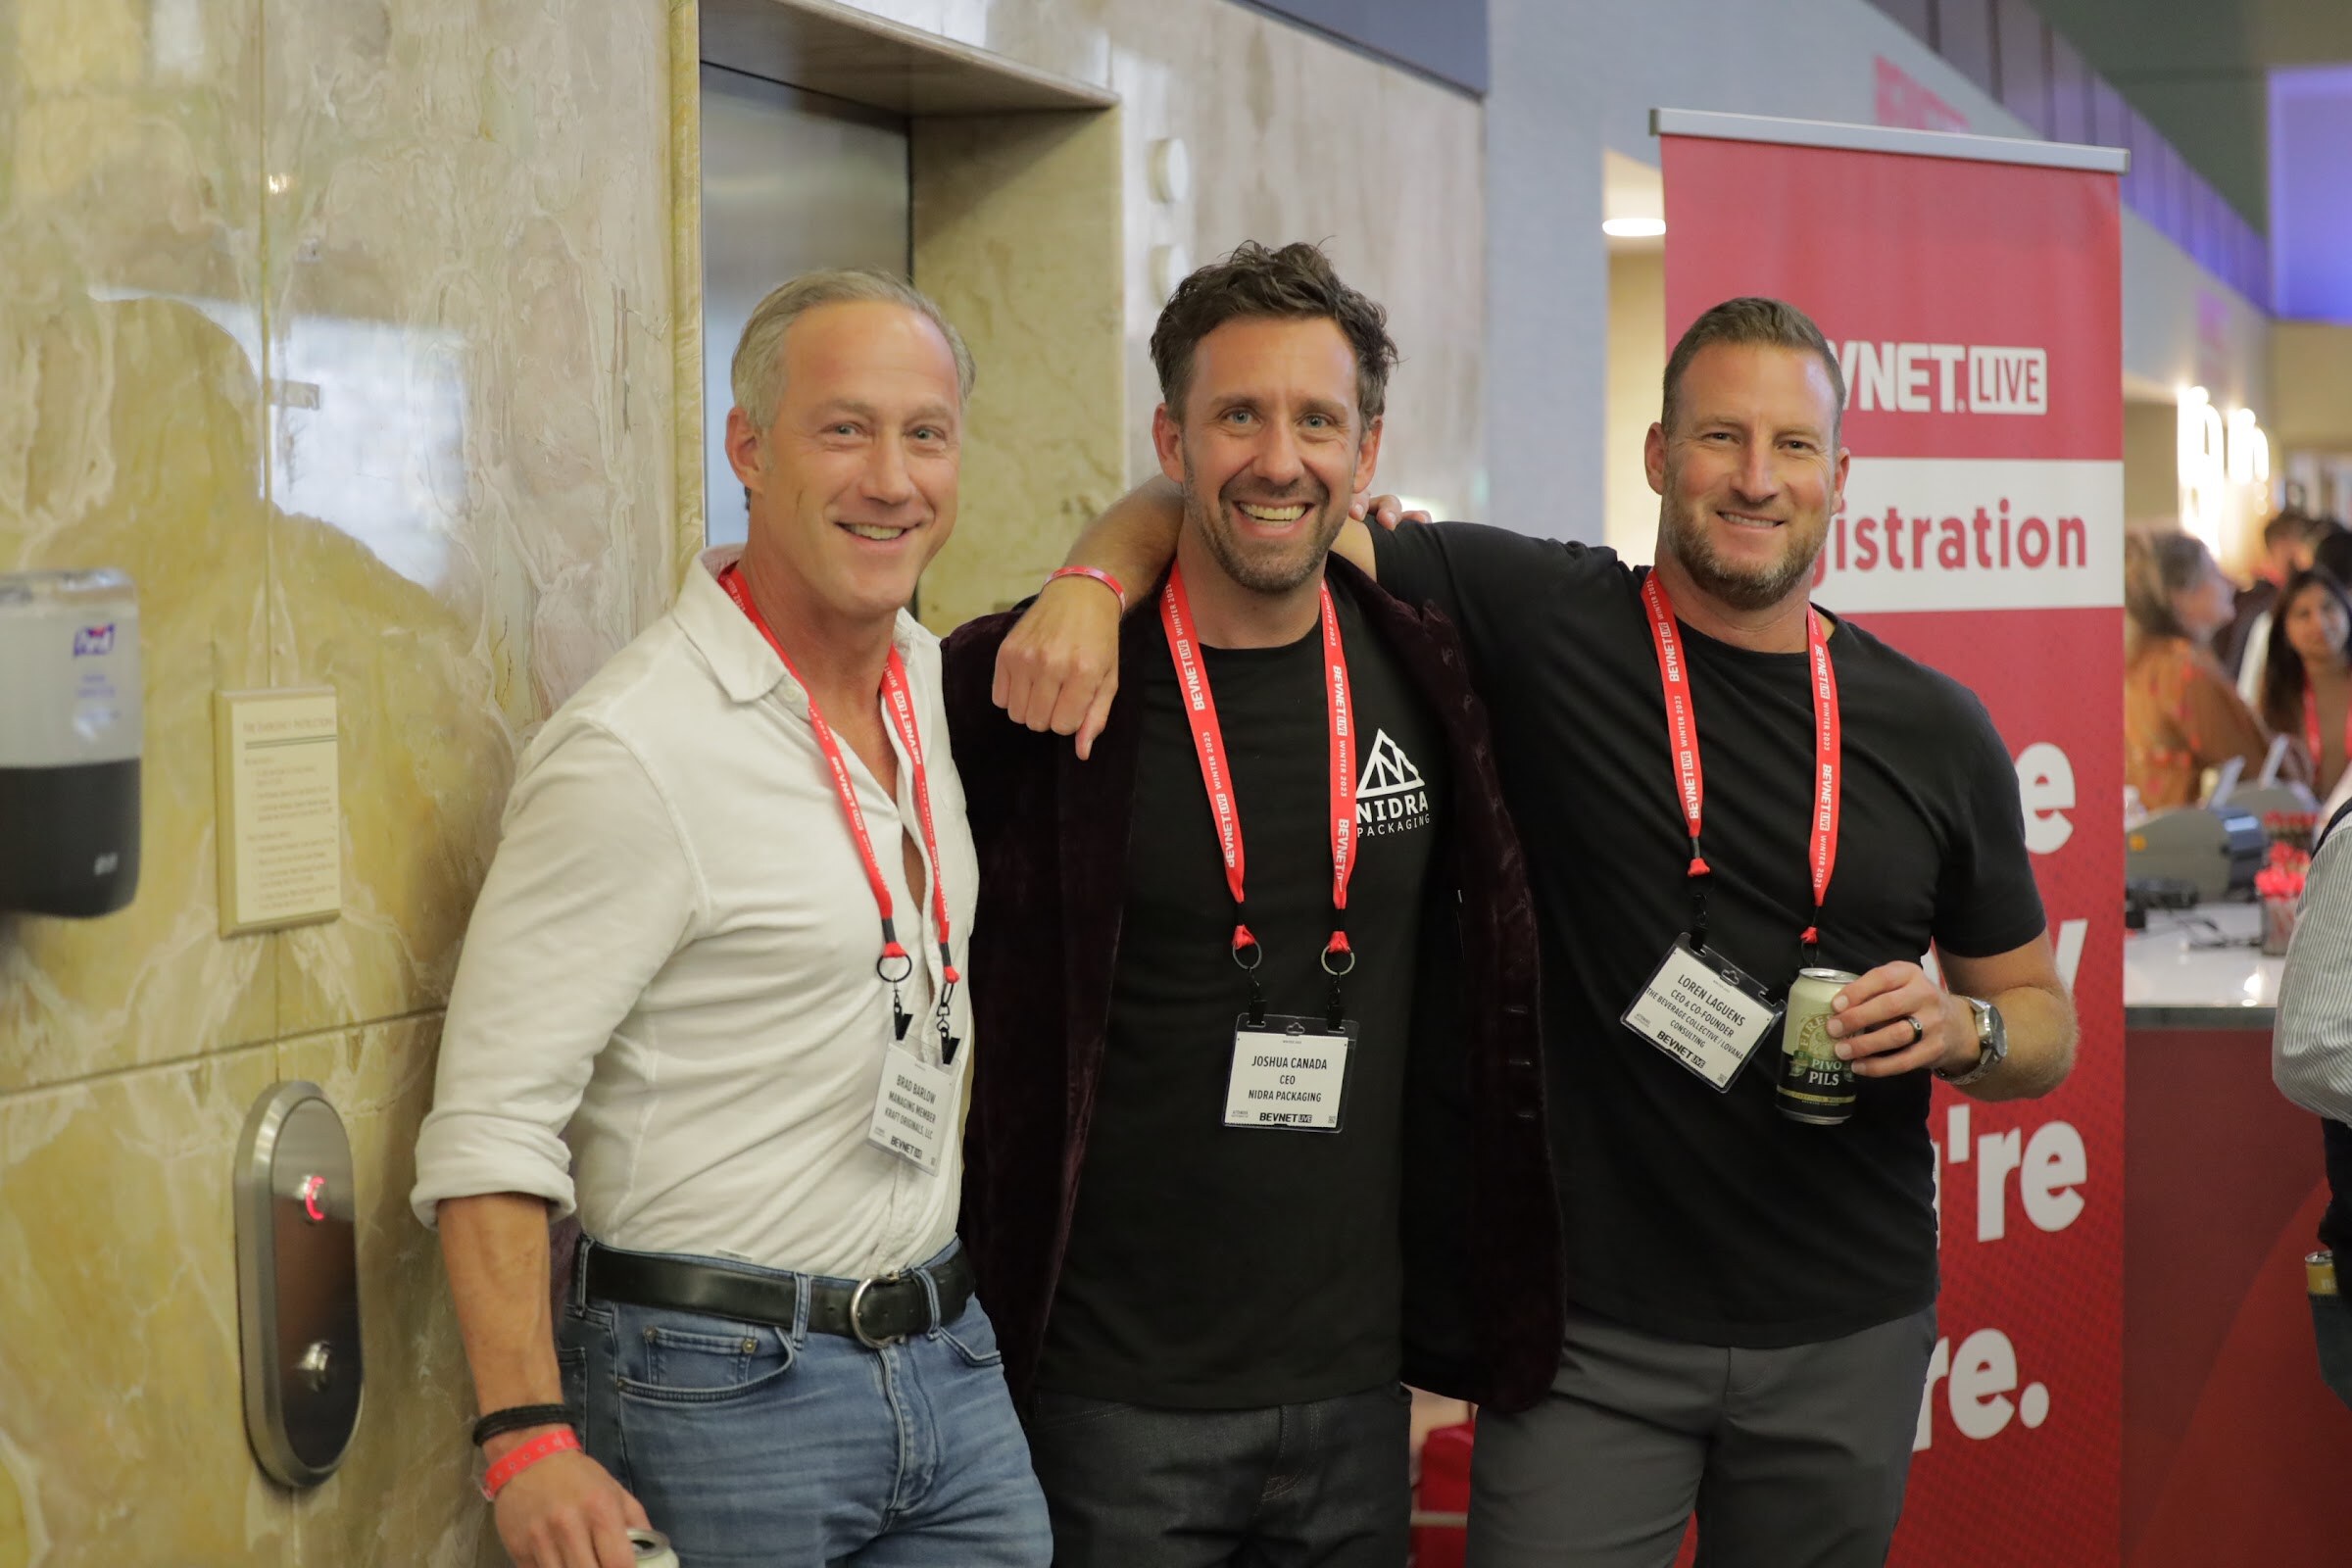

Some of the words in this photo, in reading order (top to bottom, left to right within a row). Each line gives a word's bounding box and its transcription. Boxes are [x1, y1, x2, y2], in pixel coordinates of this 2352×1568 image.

[1975, 353, 2042, 408] LIVE
[1813, 497, 2087, 589] istration
[1165, 583, 1175, 603] 2023
[1650, 596, 1664, 619] WINTER
[1169, 604, 1184, 636] WINTER
[1658, 621, 1672, 638] LIVE
[1177, 639, 1192, 660] LIVE
[1662, 637, 1680, 682] BEVNET
[1815, 644, 1829, 686] BEVNET
[1182, 659, 1205, 710] BEVNET
[1332, 664, 1346, 716] BEVNET
[1819, 684, 1831, 700] LIVE
[892, 690, 907, 711] LIVE
[1674, 695, 1684, 714] 2023
[900, 710, 921, 764] BEVNET
[1336, 715, 1348, 737] LIVE
[1677, 715, 1688, 747] WINTER
[1202, 731, 1214, 754] 2023
[1208, 755, 1222, 790] WINTER
[1680, 751, 1693, 770] LIVE
[831, 755, 857, 809] BEVNET
[1683, 770, 1699, 819] BEVNET
[1821, 763, 1833, 813] BEVNET
[1216, 793, 1230, 814] LIVE
[1356, 791, 1429, 824] NIDRA
[1356, 812, 1430, 838] PACKAGING
[1819, 811, 1831, 832] LIVE
[1335, 818, 1349, 872] BEVNET
[1818, 835, 1827, 865] WINTER
[1814, 867, 1825, 888] 2023
[1670, 989, 1686, 1004] CEO
[1690, 1003, 1735, 1038] CO-FOUNDER
[1677, 974, 1708, 1000] LOREN
[1705, 994, 1746, 1027] LAGUENS
[1645, 987, 1658, 999] THE
[1656, 994, 1686, 1019] BEVERAGE
[1685, 1015, 1721, 1044] COLLECTIVE
[1721, 1041, 1744, 1060] LOVANA
[1670, 1019, 1706, 1049] CONSULTING
[1251, 1055, 1288, 1068] JOSHUA
[1291, 1057, 1328, 1070] CANADA
[1656, 1030, 1692, 1059] BEVNET
[1690, 1054, 1706, 1069] LIVE
[1811, 1058, 1841, 1071] PIVO
[897, 1074, 912, 1092] BRAD
[912, 1083, 937, 1104] BARLOW
[1279, 1075, 1296, 1085] CEO
[1808, 1071, 1839, 1086] PILS
[888, 1091, 915, 1112] MANAGING
[915, 1104, 937, 1124] MEMBER
[1248, 1090, 1274, 1100] NIDRA
[1276, 1091, 1322, 1102] PACKAGING
[884, 1106, 901, 1122] KRAFT
[925, 1126, 934, 1140] LLC
[1259, 1112, 1298, 1123] BEVNET
[1298, 1114, 1312, 1123] LIVE
[891, 1135, 914, 1154] BEVNET
